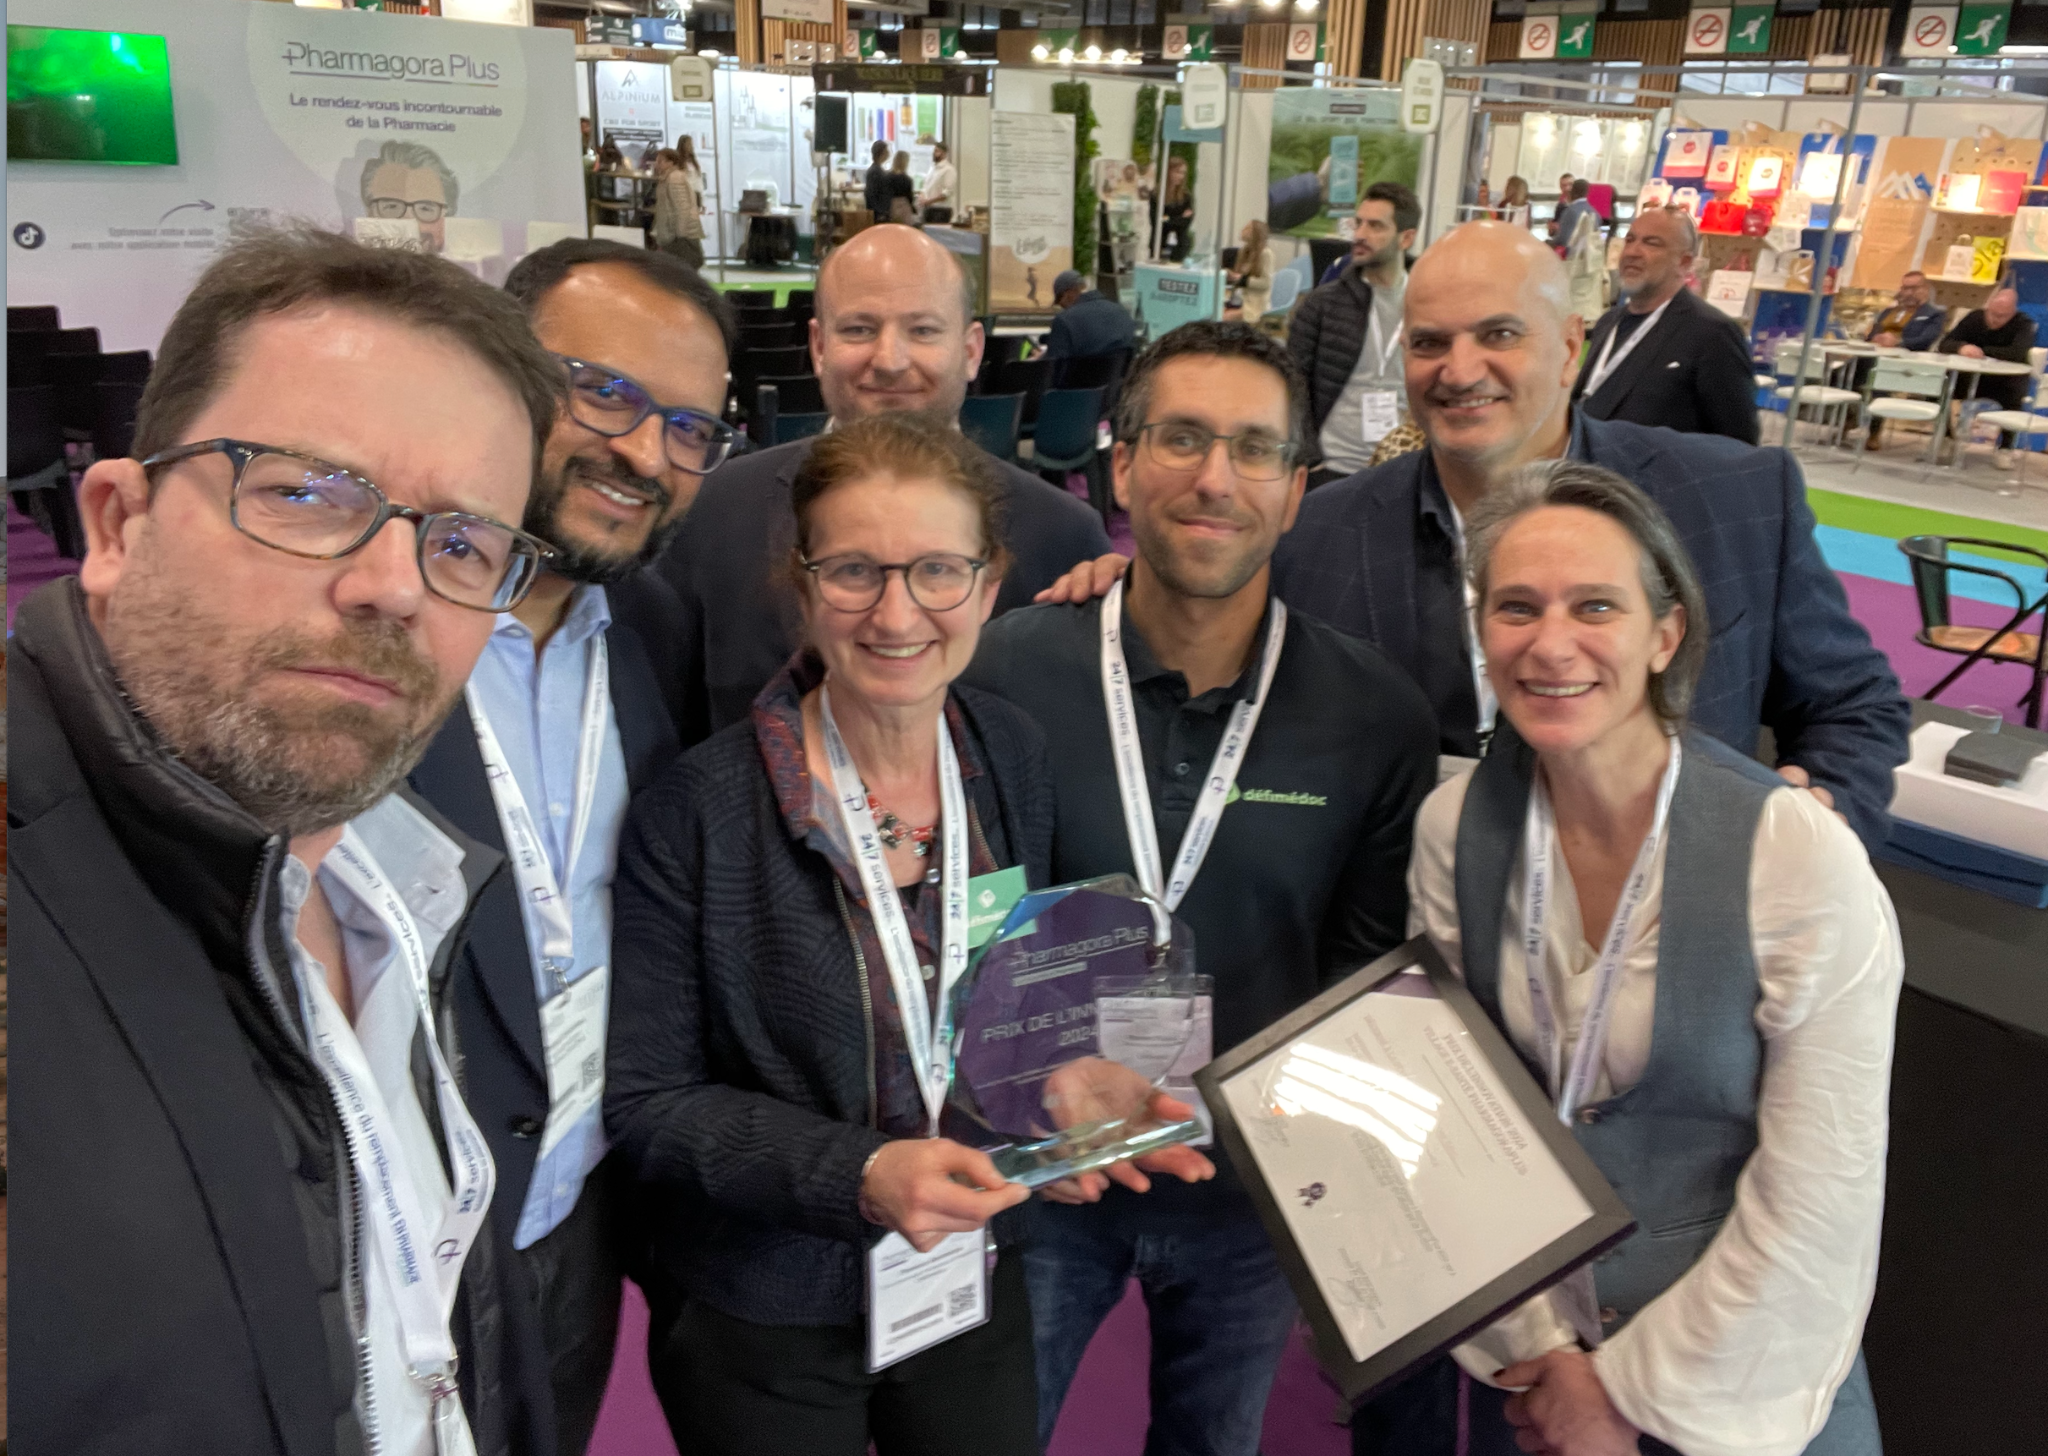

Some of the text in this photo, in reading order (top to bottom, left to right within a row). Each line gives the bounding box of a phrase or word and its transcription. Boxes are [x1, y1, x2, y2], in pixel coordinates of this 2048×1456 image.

[282, 41, 500, 81] Pharmagora Plus
[289, 92, 503, 117] Le rendez-vous incontournable
[346, 115, 456, 132] de la Pharmacie
[1006, 924, 1149, 969] Pharmagora Plus
[981, 1021, 1025, 1043] PRIX
[1027, 1013, 1056, 1032] DE
[361, 1114, 374, 1131] du
